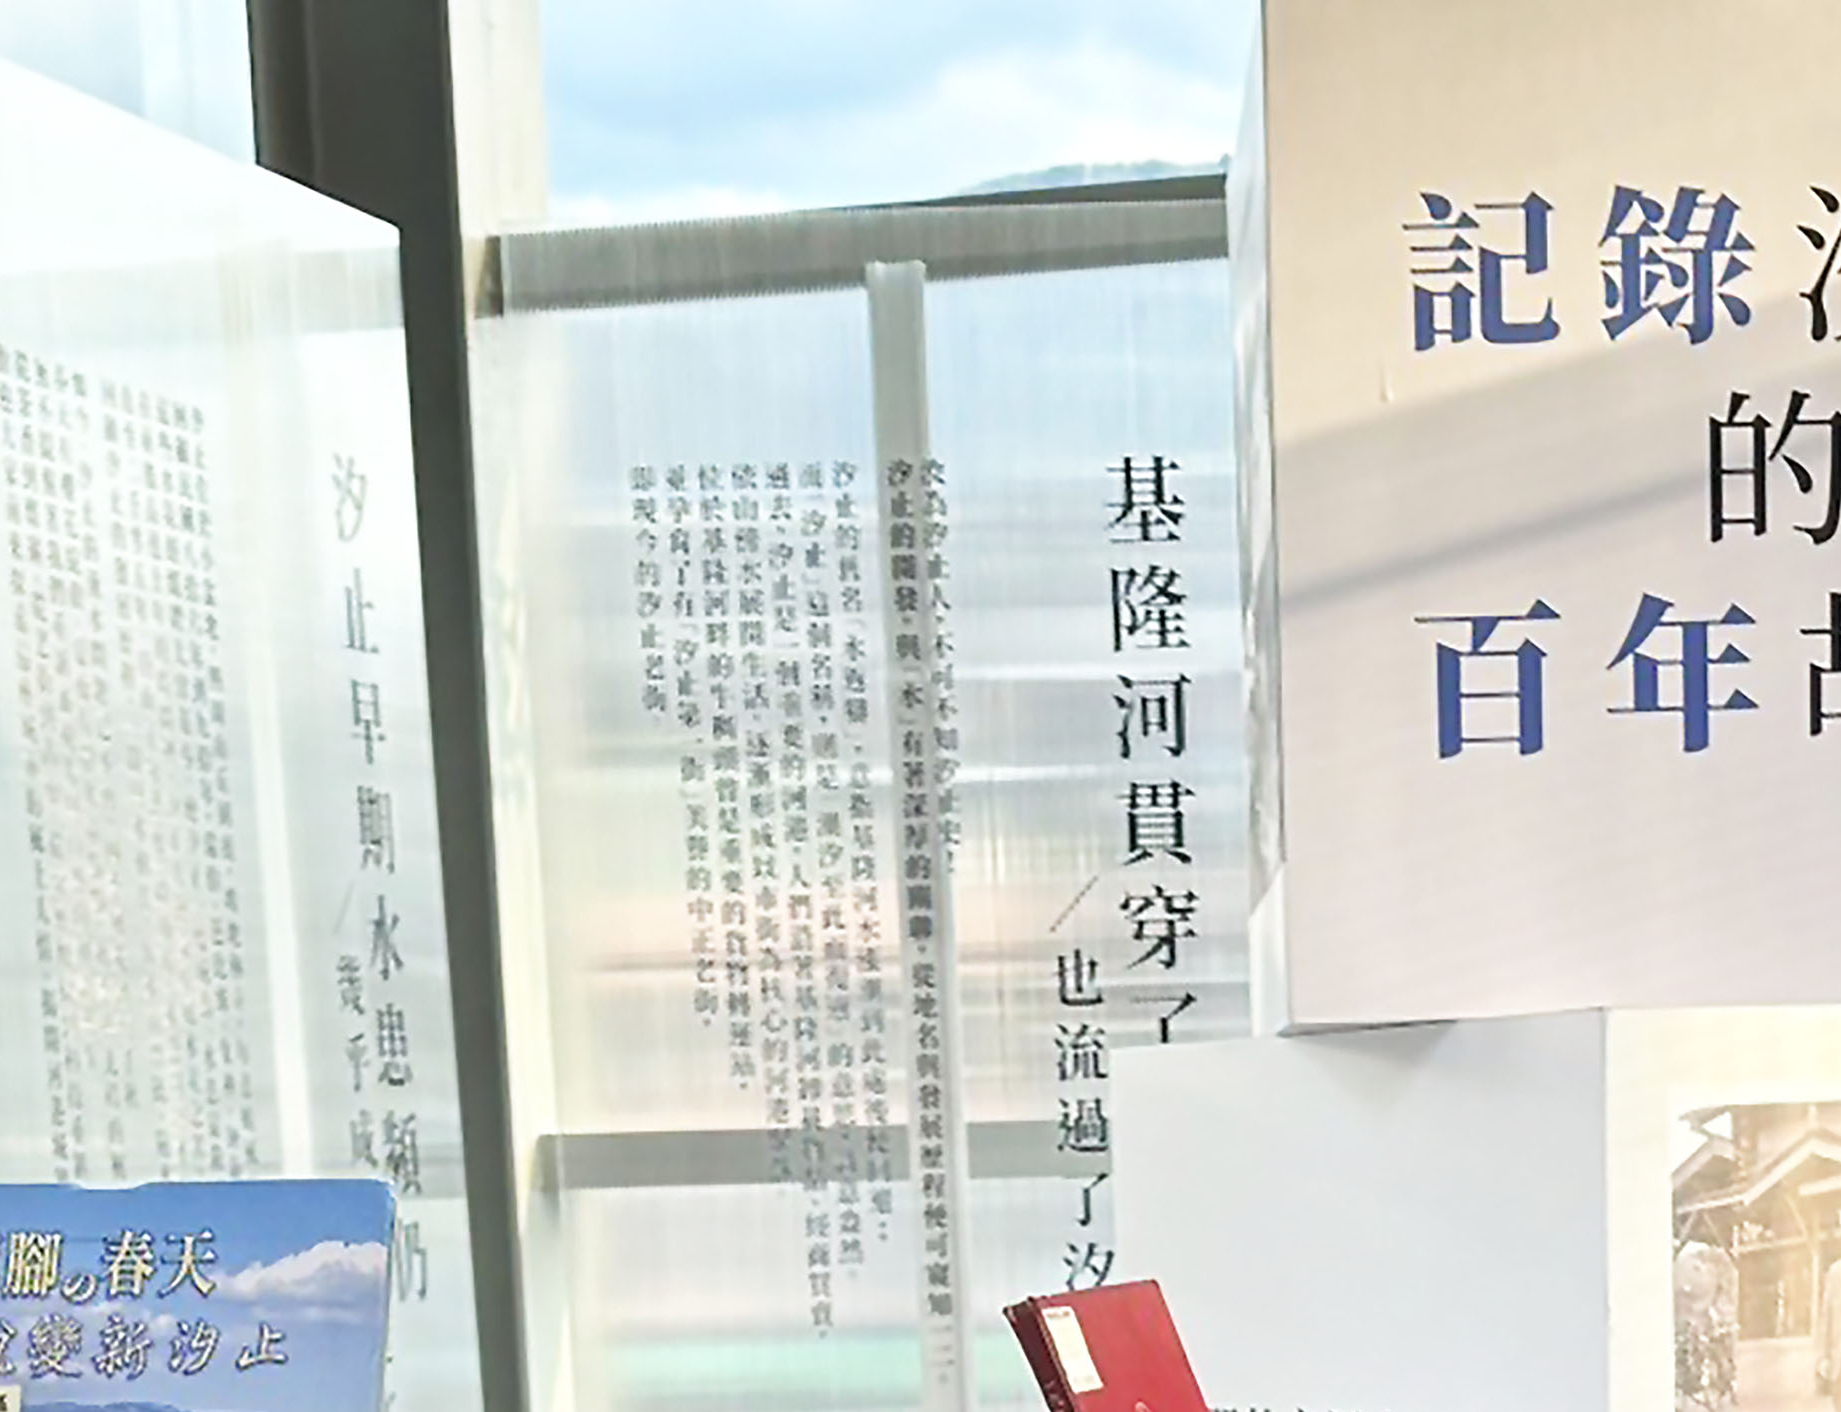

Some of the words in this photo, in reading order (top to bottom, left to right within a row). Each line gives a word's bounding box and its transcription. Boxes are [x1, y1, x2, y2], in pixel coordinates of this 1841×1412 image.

[1105, 455, 1200, 1044] 基隆河貫穿了
